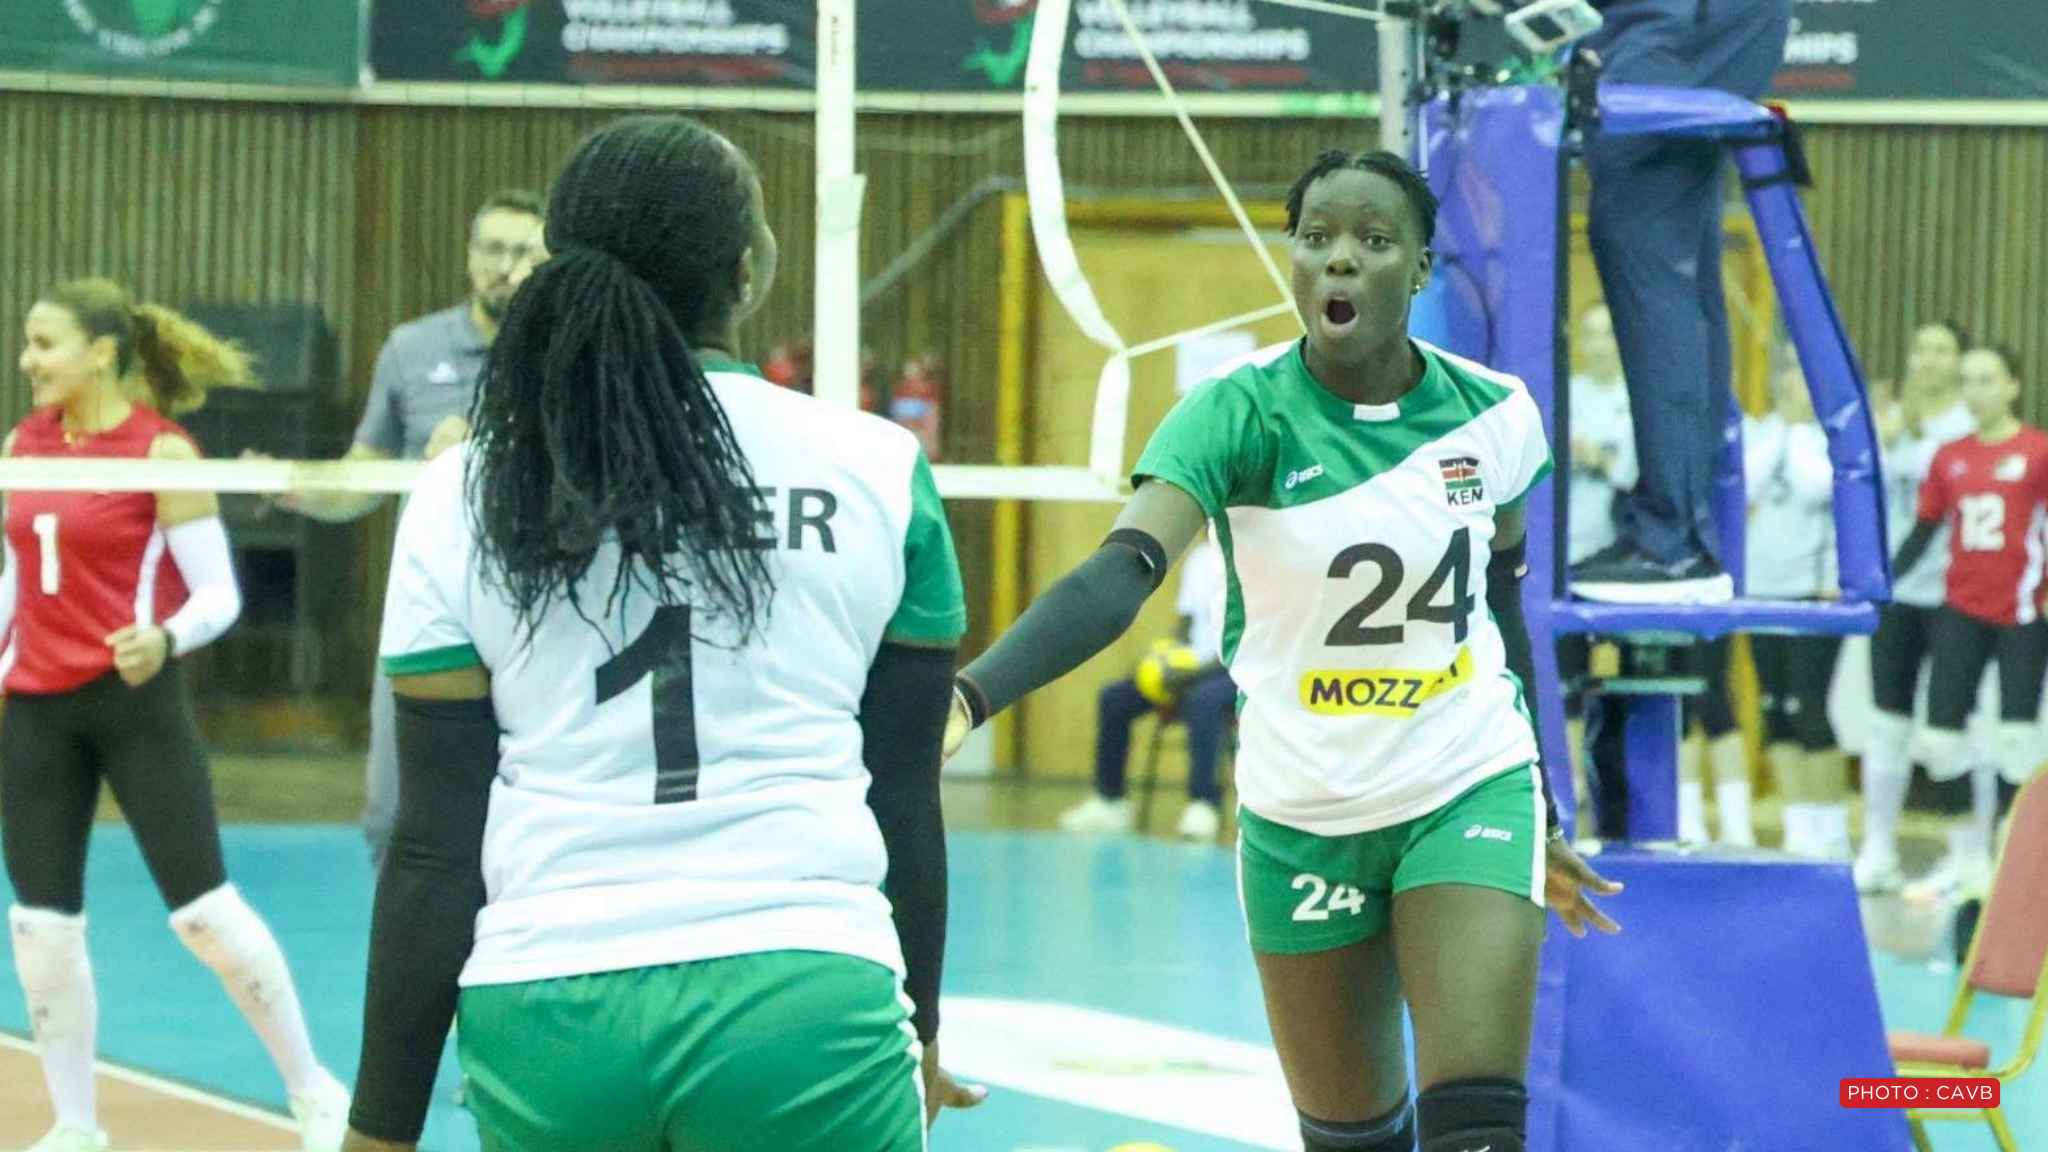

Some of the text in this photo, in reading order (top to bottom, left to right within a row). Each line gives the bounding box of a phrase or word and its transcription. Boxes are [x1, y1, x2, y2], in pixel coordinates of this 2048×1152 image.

[562, 22, 789, 54] CHAMPIONSHIPS
[1447, 487, 1484, 507] KEN
[1957, 493, 2006, 550] 12
[33, 514, 60, 595] 1
[1324, 526, 1475, 646] 24
[595, 604, 699, 804] 1
[1291, 873, 1366, 922] 24
